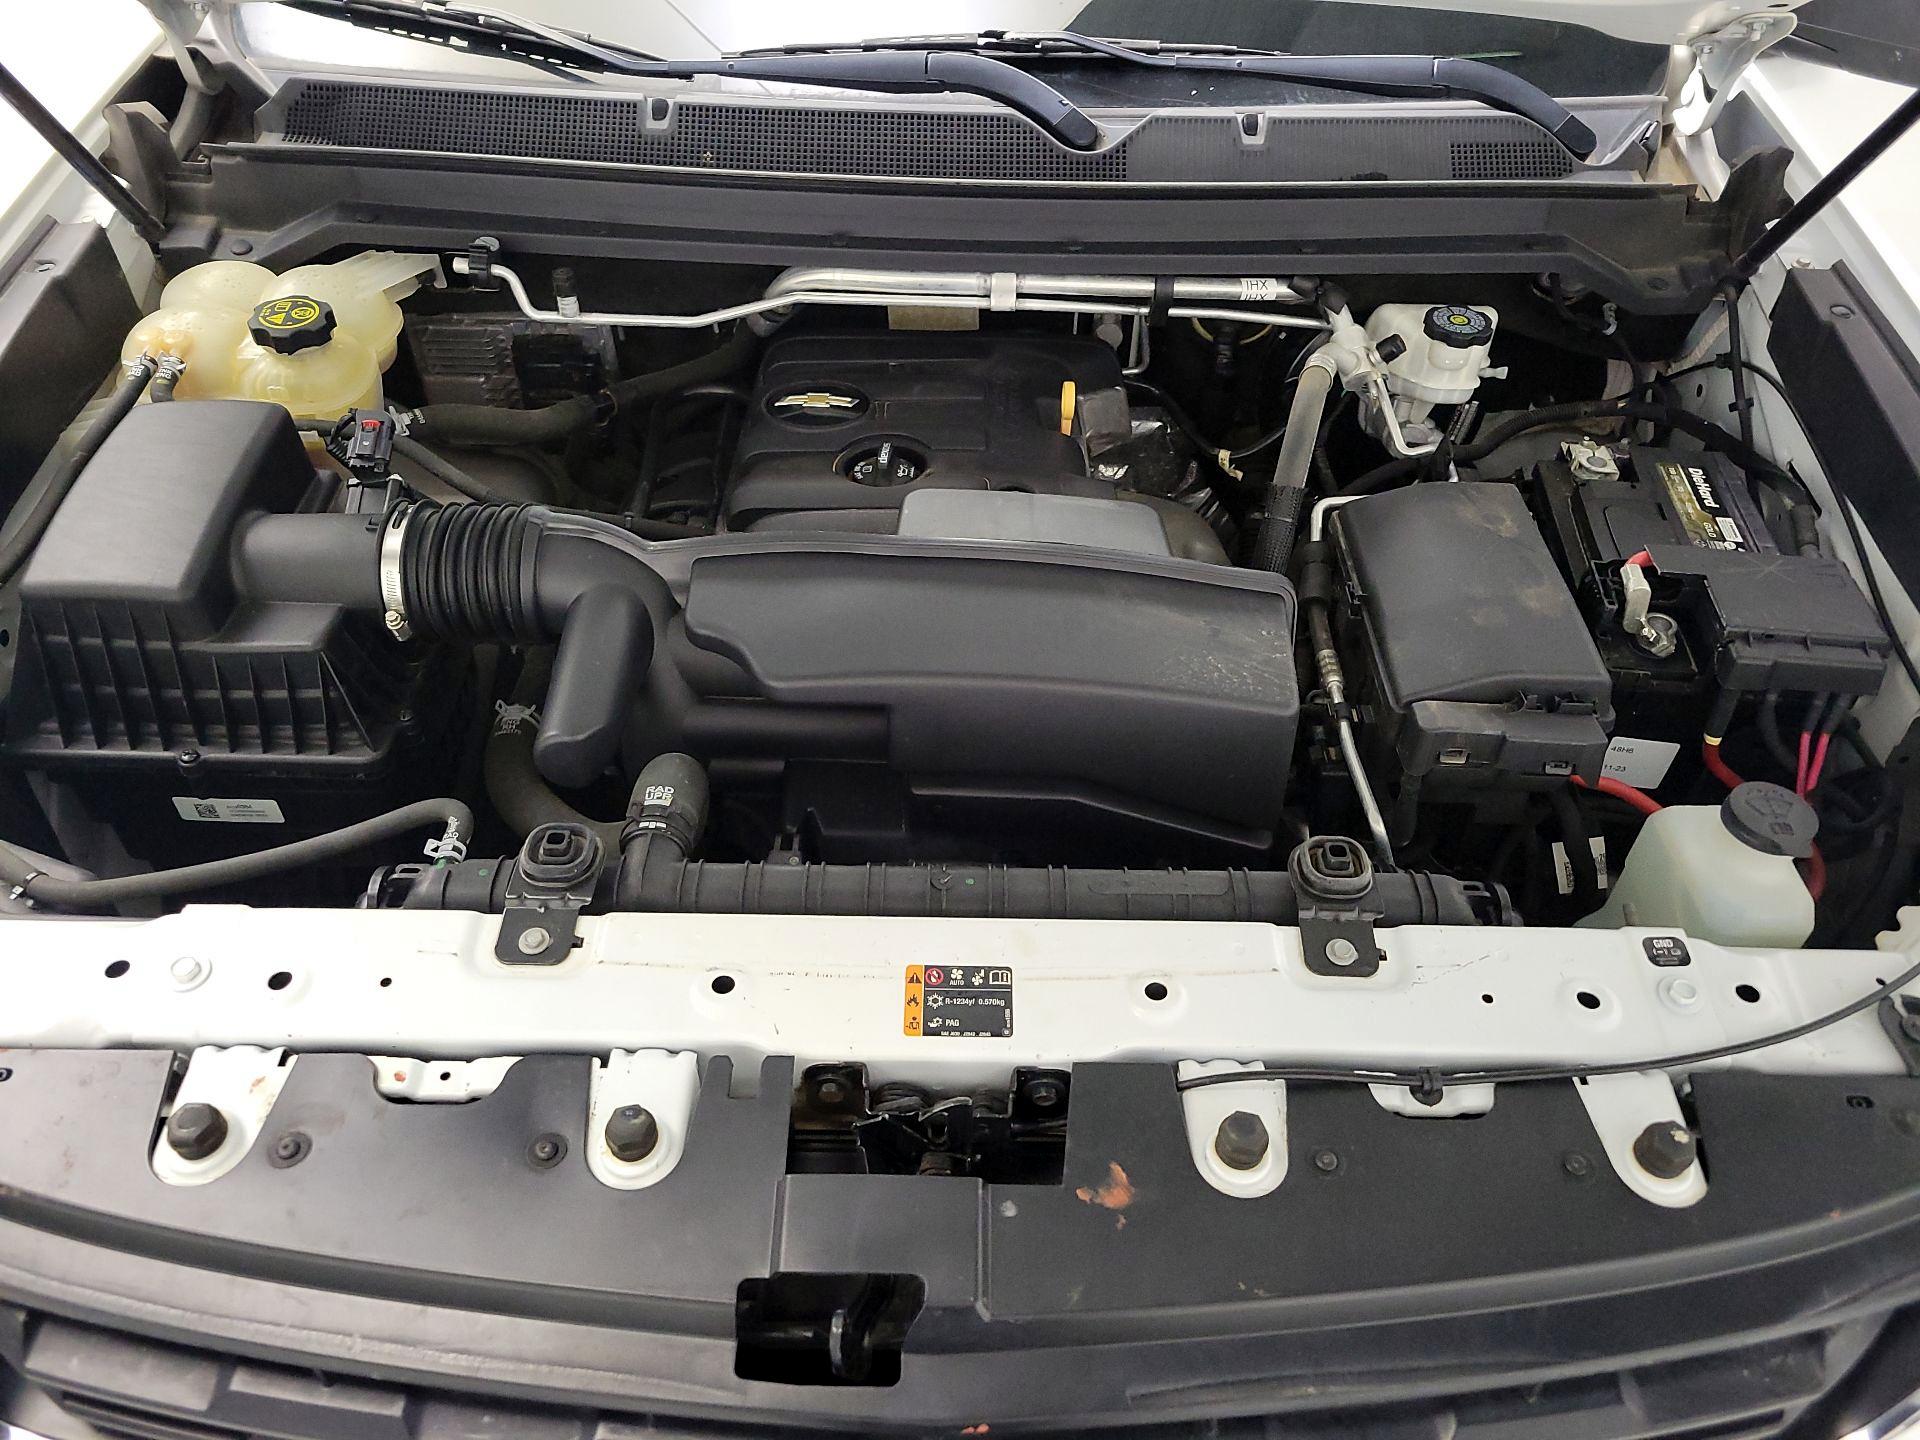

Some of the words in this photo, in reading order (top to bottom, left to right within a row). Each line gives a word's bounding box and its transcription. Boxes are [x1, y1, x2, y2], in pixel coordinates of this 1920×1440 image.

[1688, 467, 1720, 508] DieHard
[1703, 522, 1717, 538] GOLD
[646, 785, 675, 794] RAD
[1652, 939, 1674, 949] GND
[945, 998, 975, 1006] R-1234yf
[978, 998, 1005, 1007] 0.570kg
[945, 1019, 960, 1027] PAG
